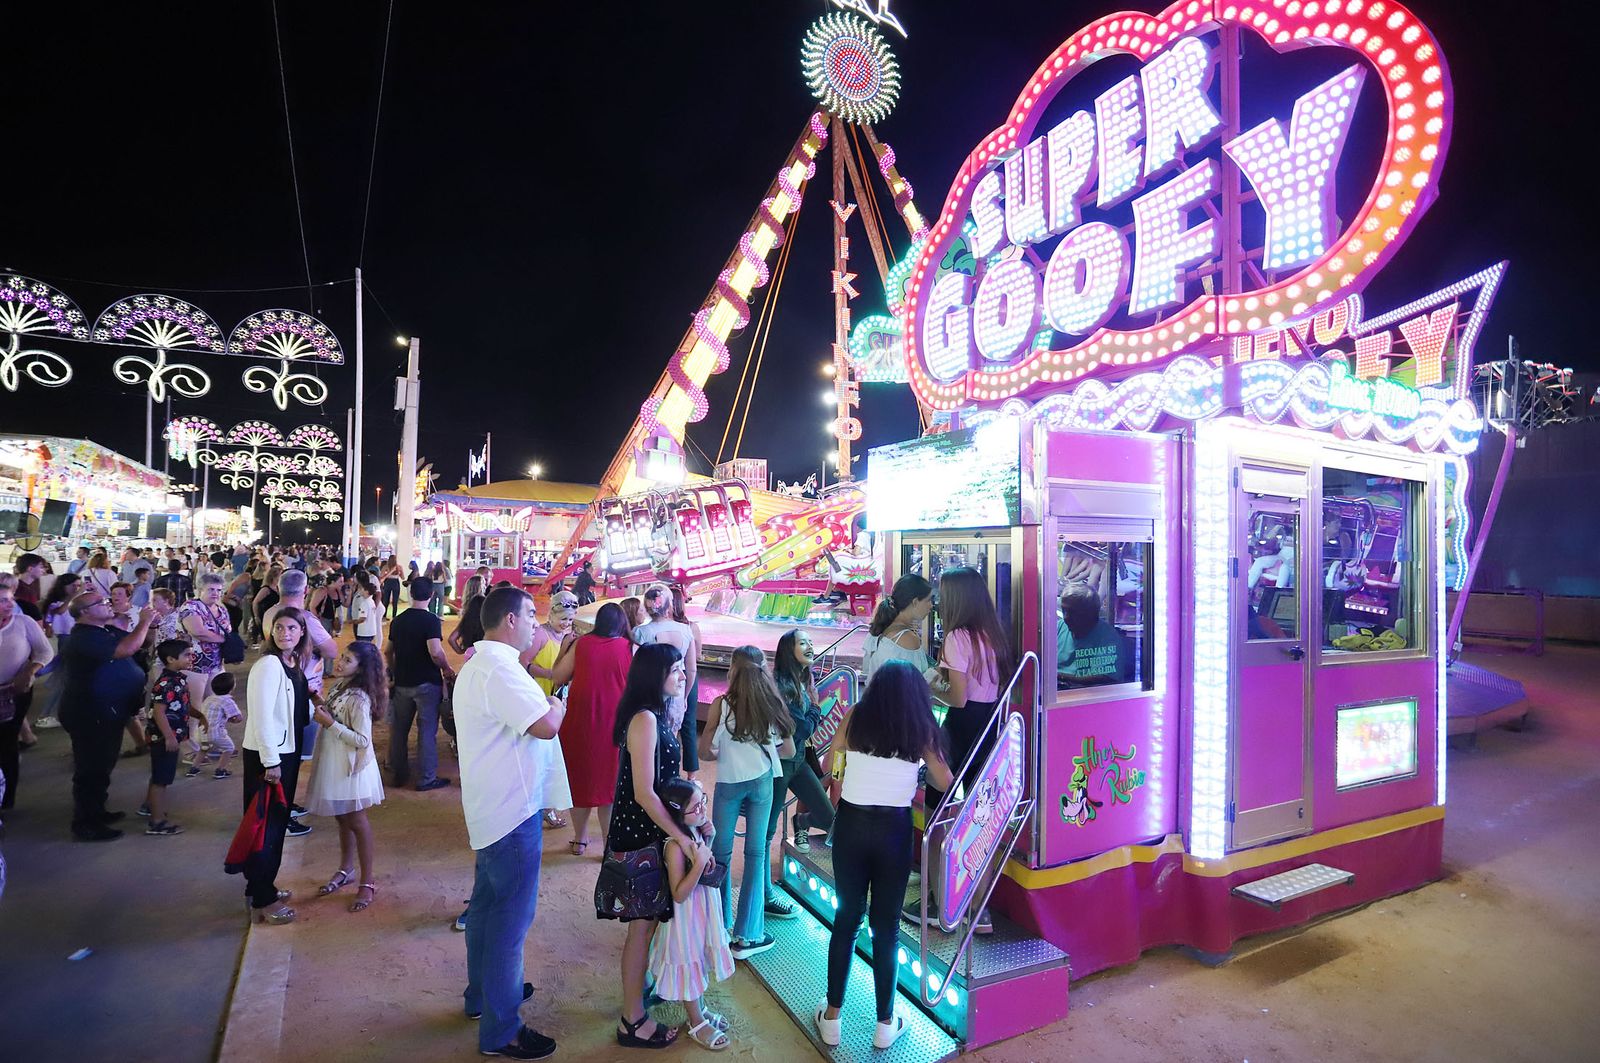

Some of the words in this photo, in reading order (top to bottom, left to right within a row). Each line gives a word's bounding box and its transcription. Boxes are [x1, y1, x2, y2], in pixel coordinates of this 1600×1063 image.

[971, 37, 1222, 258] SUPER
[922, 63, 1367, 384] GOOFY
[1075, 647, 1107, 658] RECOJAN
[1107, 645, 1117, 654] SU
[1099, 762, 1146, 806] Rubio
[962, 820, 996, 881] SUPER
